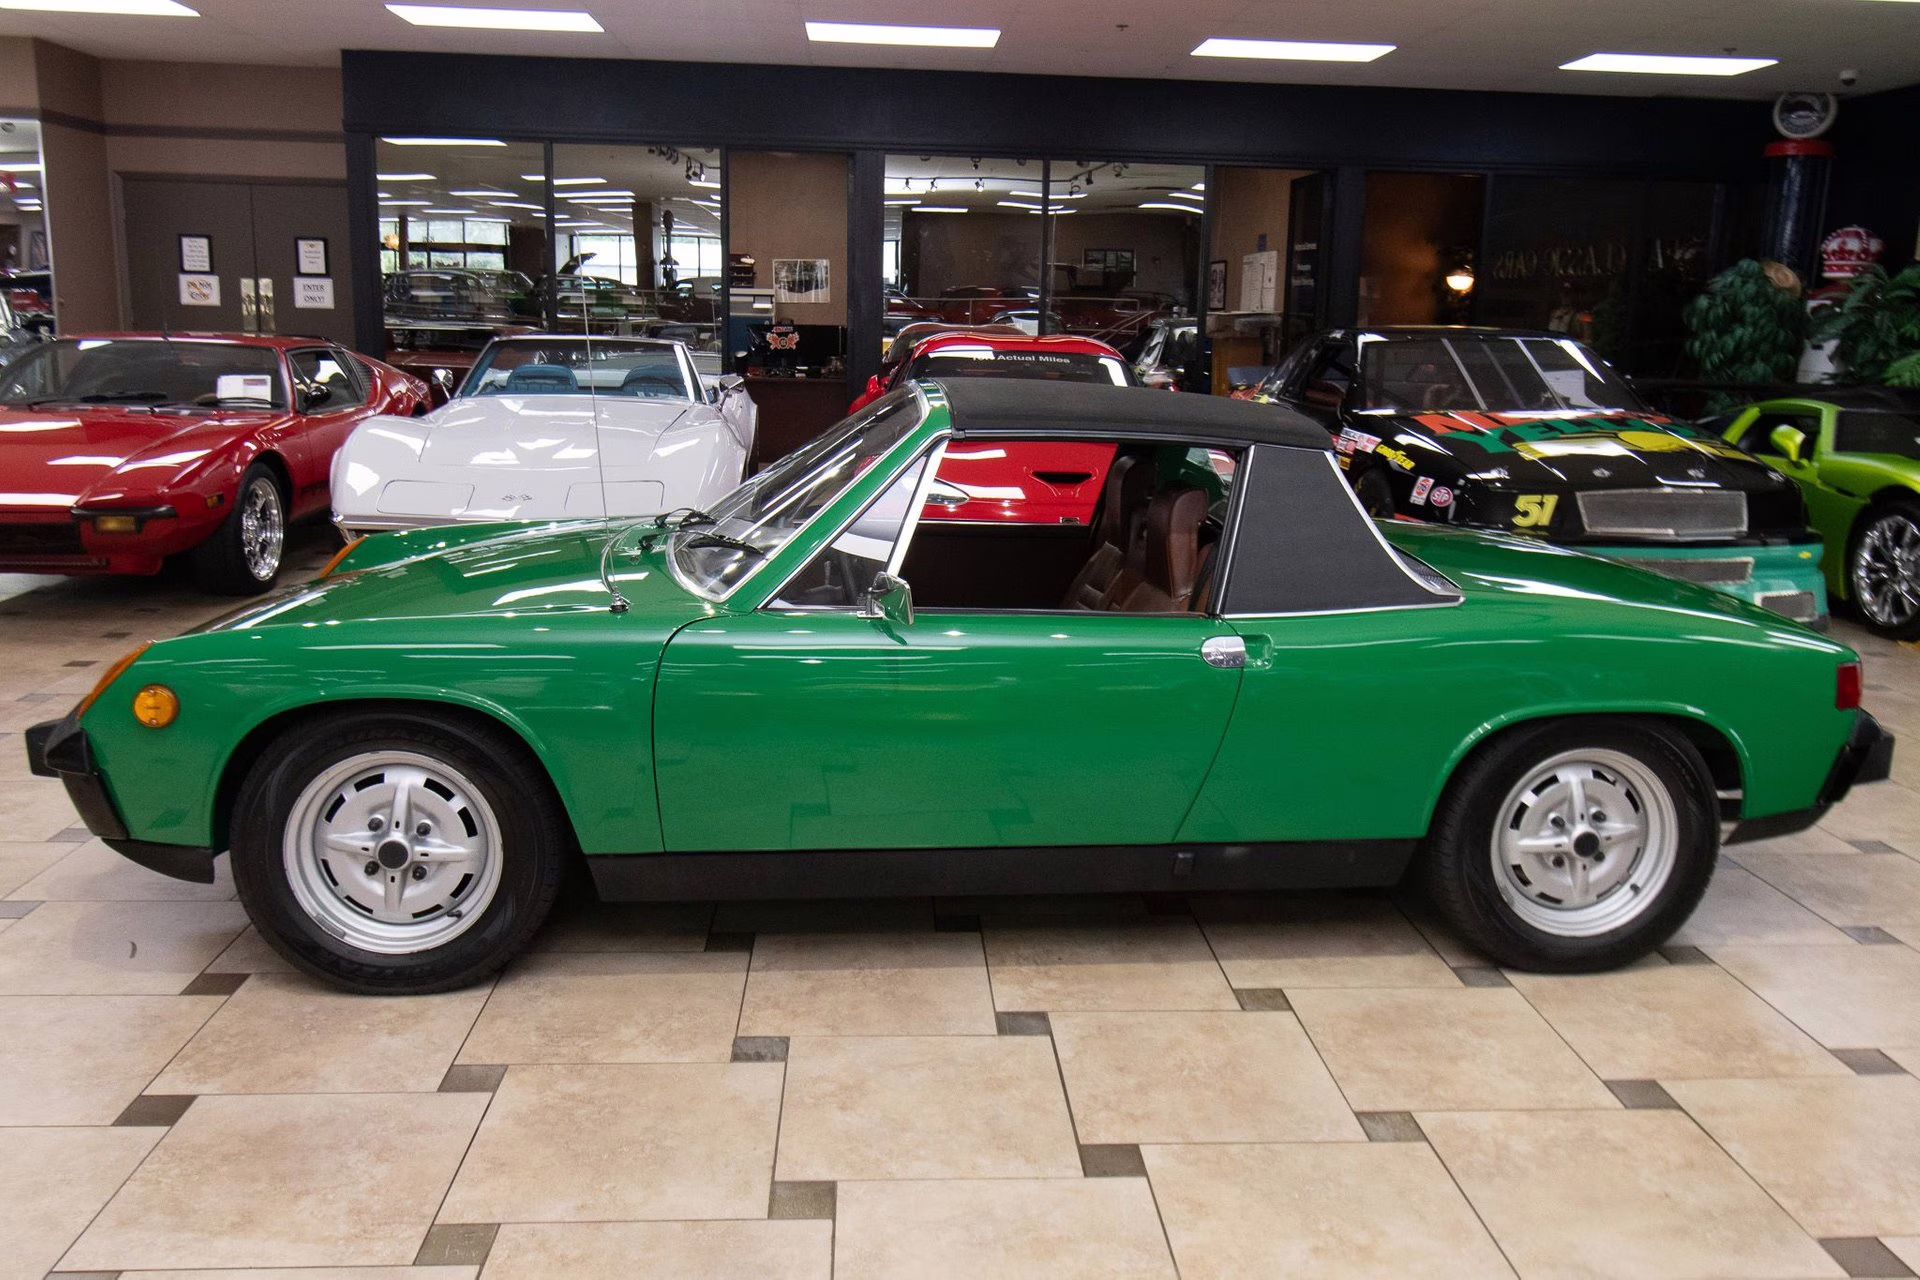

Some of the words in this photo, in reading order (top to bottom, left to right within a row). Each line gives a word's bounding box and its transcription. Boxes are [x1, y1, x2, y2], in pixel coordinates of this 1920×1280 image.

[302, 283, 325, 292] ENTER
[1039, 355, 1071, 363] Miles
[1512, 494, 1559, 527] 51
